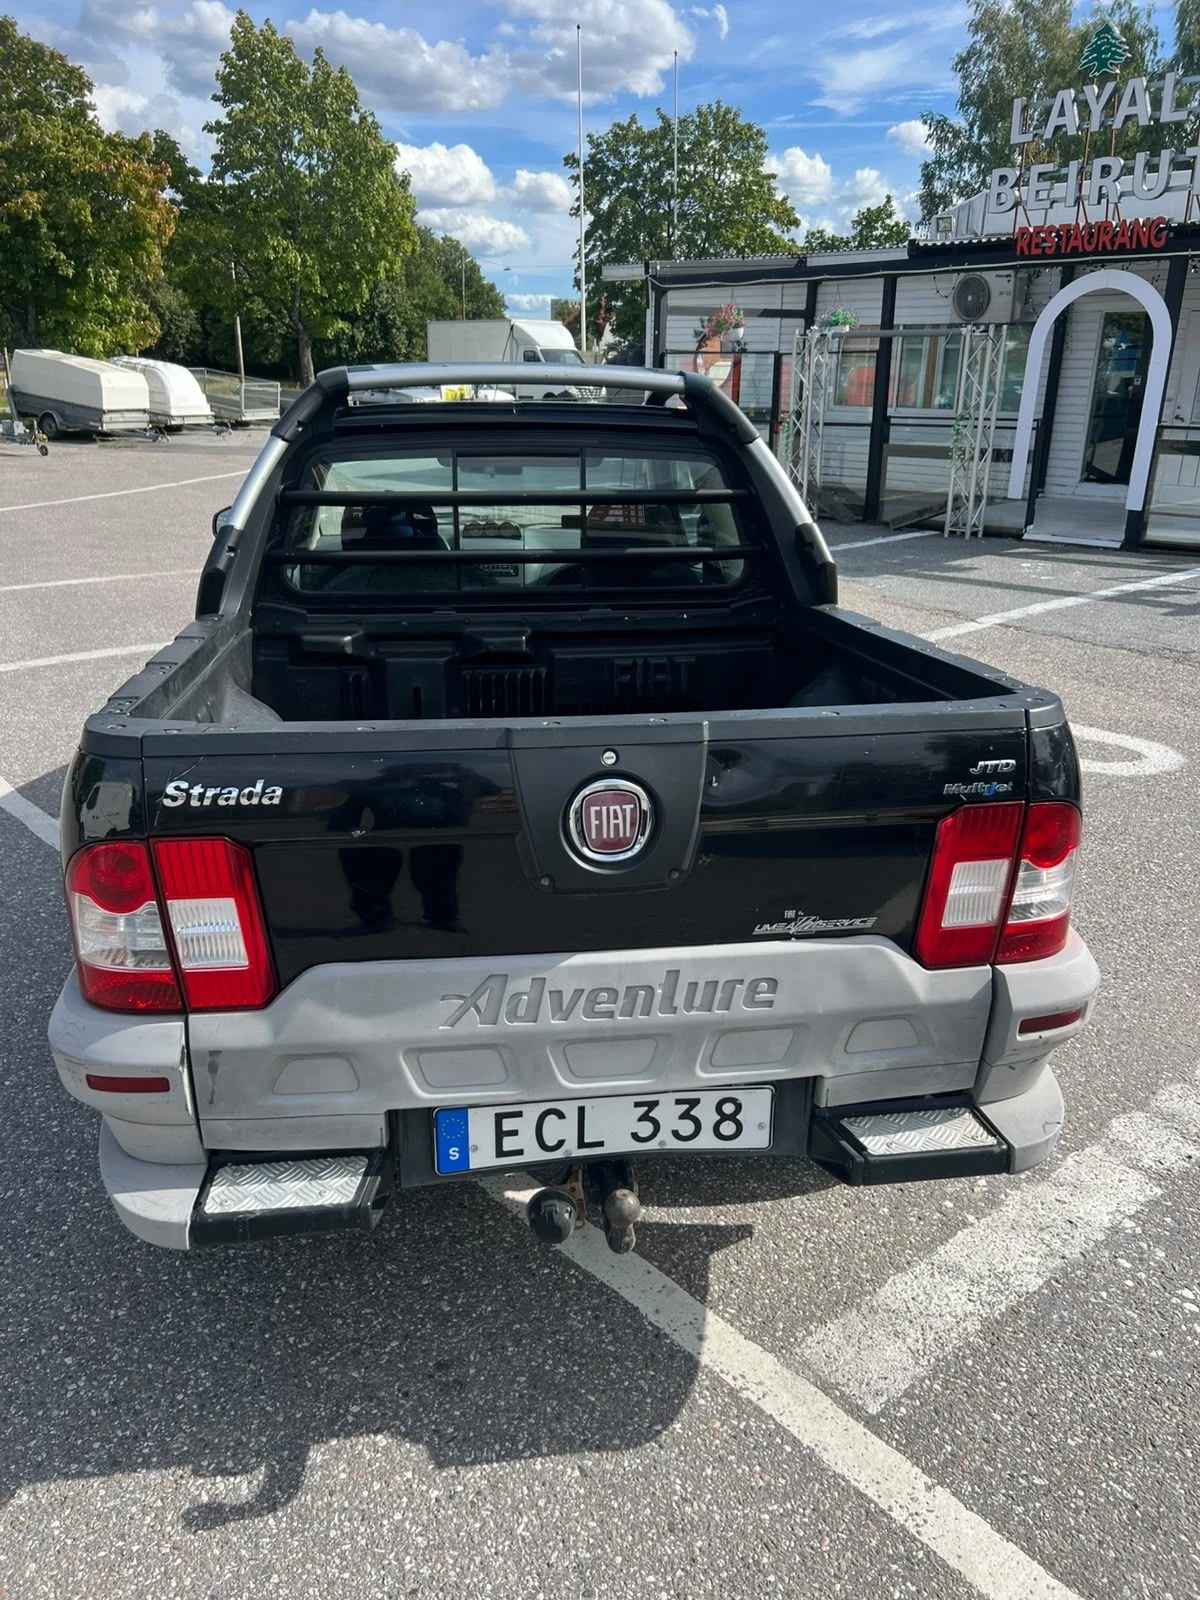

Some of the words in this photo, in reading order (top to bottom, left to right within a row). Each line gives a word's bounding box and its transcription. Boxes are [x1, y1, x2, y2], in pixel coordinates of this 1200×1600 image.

[988, 147, 1200, 214] BEIRUT
[1015, 216, 1168, 256] RESTAURANG
[969, 759, 1017, 775] JTD
[162, 779, 283, 807] Strada
[590, 804, 634, 840] FIAT
[438, 969, 778, 1029] Adventure
[494, 1105, 605, 1158] ECL
[630, 1096, 744, 1143] 338
[448, 1147, 460, 1160] S
